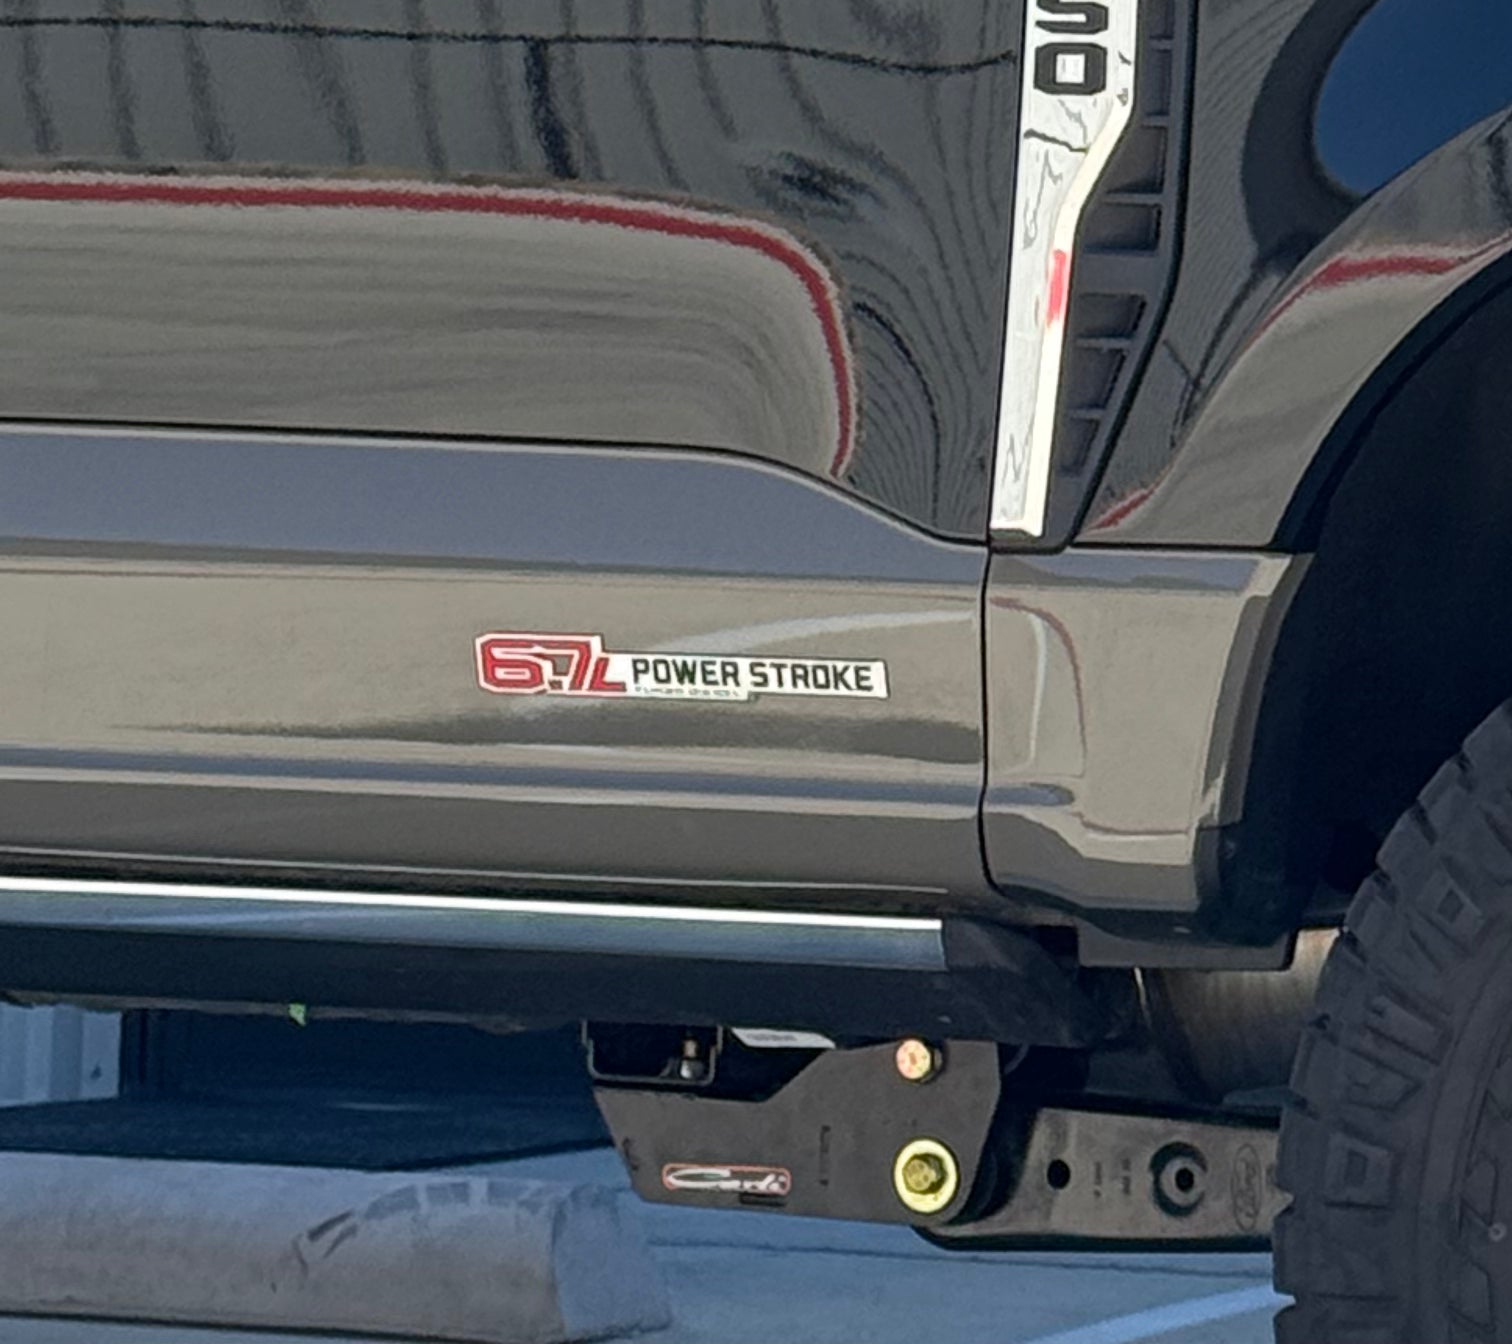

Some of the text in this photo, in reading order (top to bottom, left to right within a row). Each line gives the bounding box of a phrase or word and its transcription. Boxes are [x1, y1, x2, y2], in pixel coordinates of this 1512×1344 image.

[480, 638, 627, 693] 6.7L
[631, 658, 741, 687] POWER
[750, 661, 874, 692] STROKE
